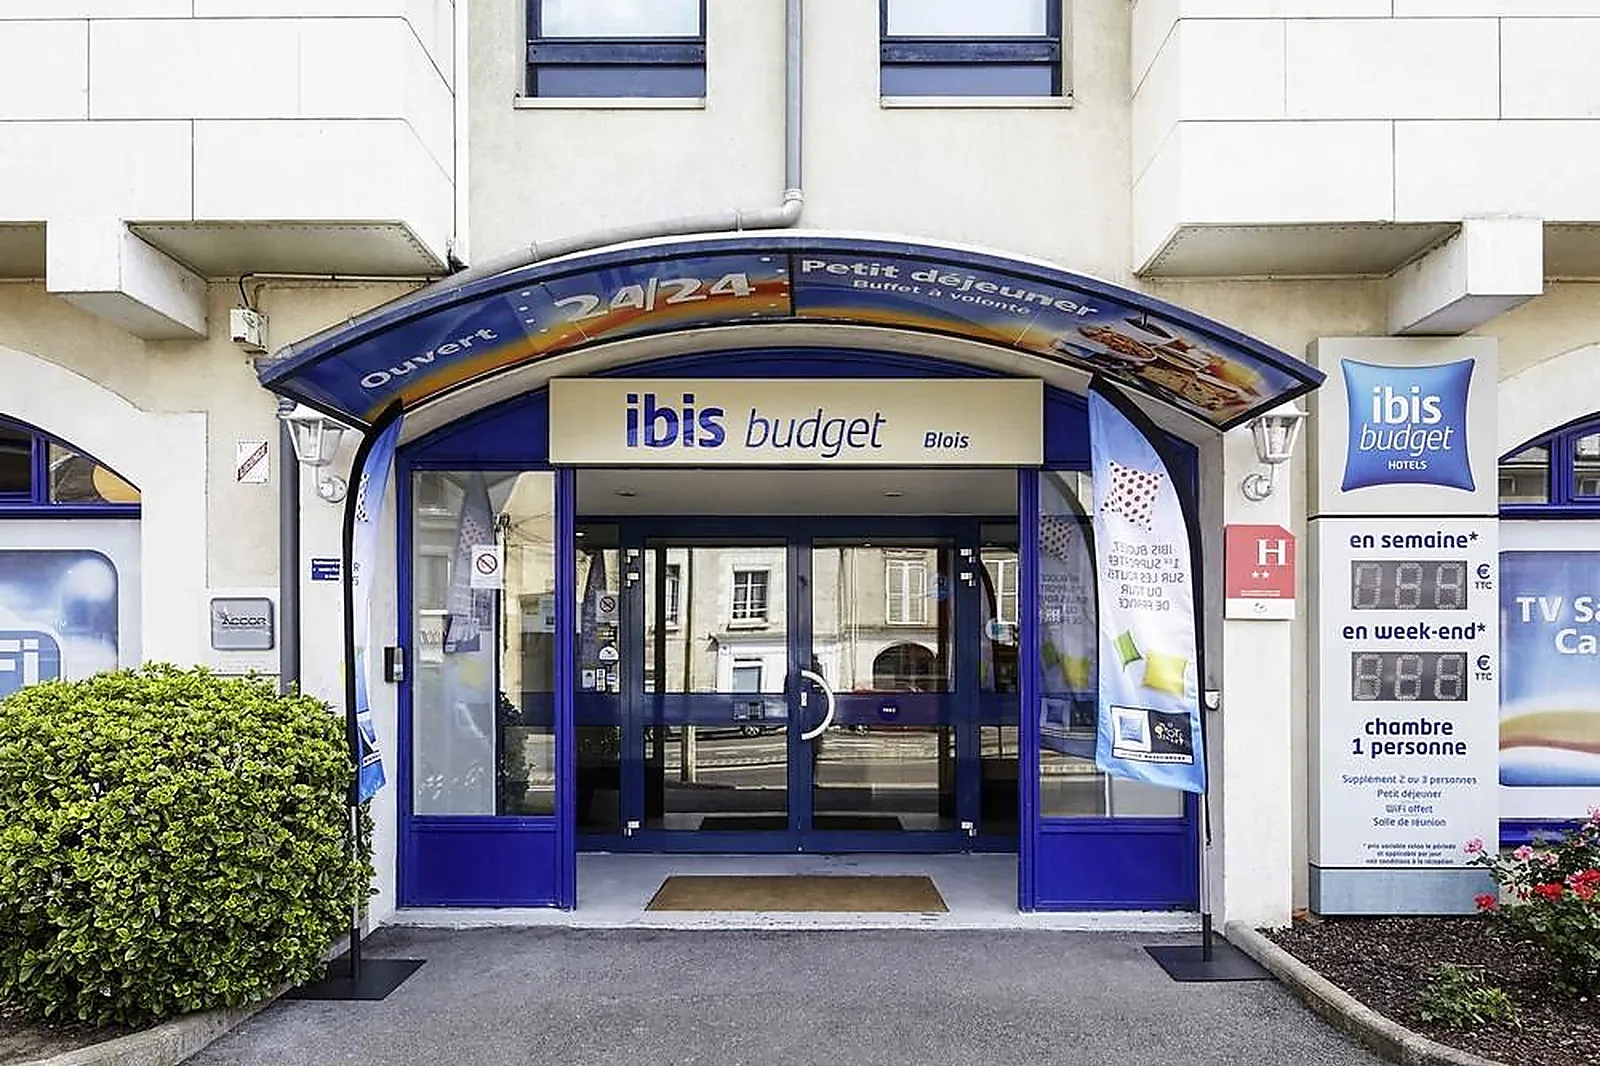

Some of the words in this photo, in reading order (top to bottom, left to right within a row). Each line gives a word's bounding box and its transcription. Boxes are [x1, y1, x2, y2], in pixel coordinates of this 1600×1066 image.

[802, 260, 899, 279] Petit
[911, 269, 1099, 317] déjeuner
[854, 280, 921, 294] Buffet
[930, 288, 942, 298] à
[951, 293, 1031, 315] volonté
[361, 329, 498, 388] Ouvert
[554, 273, 756, 322] 24/24
[1372, 384, 1443, 425] ibis
[626, 393, 726, 448] ibis
[745, 408, 886, 458] budget
[923, 431, 970, 449] Blois
[1359, 426, 1454, 456] budget
[1388, 461, 1428, 470] HOTELS
[1350, 534, 1375, 549] en
[1256, 538, 1286, 567] H
[1475, 582, 1493, 590] TTC
[1516, 596, 1563, 622] TV
[222, 612, 268, 626] ACCOR
[1343, 625, 1367, 640] en
[1555, 628, 1597, 654] Ca
[1475, 673, 1493, 681] TTC
[1365, 718, 1453, 736] chambre
[1352, 738, 1364, 755] 1
[1371, 741, 1467, 759] personne
[1377, 789, 1399, 798] Petit
[1401, 788, 1442, 800] déjeuner
[1408, 804, 1433, 813] offert
[1398, 817, 1410, 826] de
